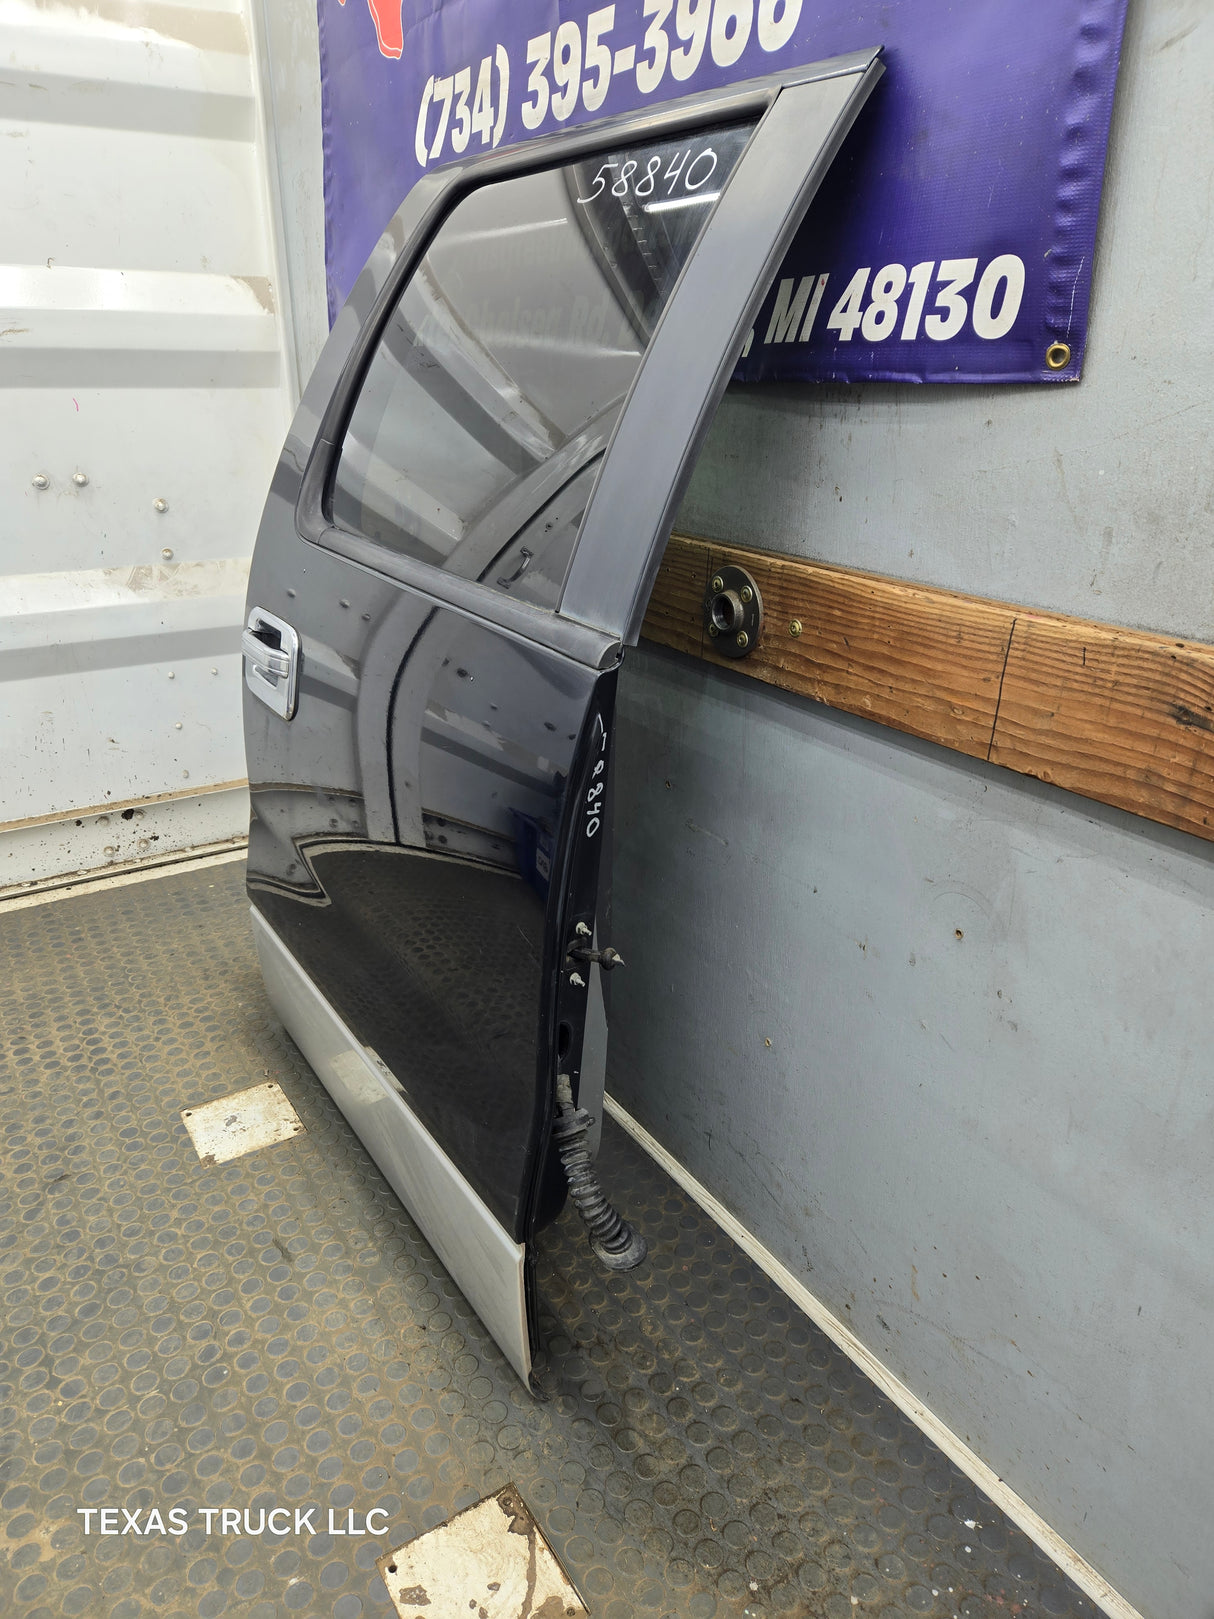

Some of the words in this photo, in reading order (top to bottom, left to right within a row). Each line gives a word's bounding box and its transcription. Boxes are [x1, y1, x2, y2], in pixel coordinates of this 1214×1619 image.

[414, 43, 510, 168] (734)
[576, 147, 718, 204] 58840
[763, 272, 831, 345] MI
[826, 253, 1026, 342] 48130
